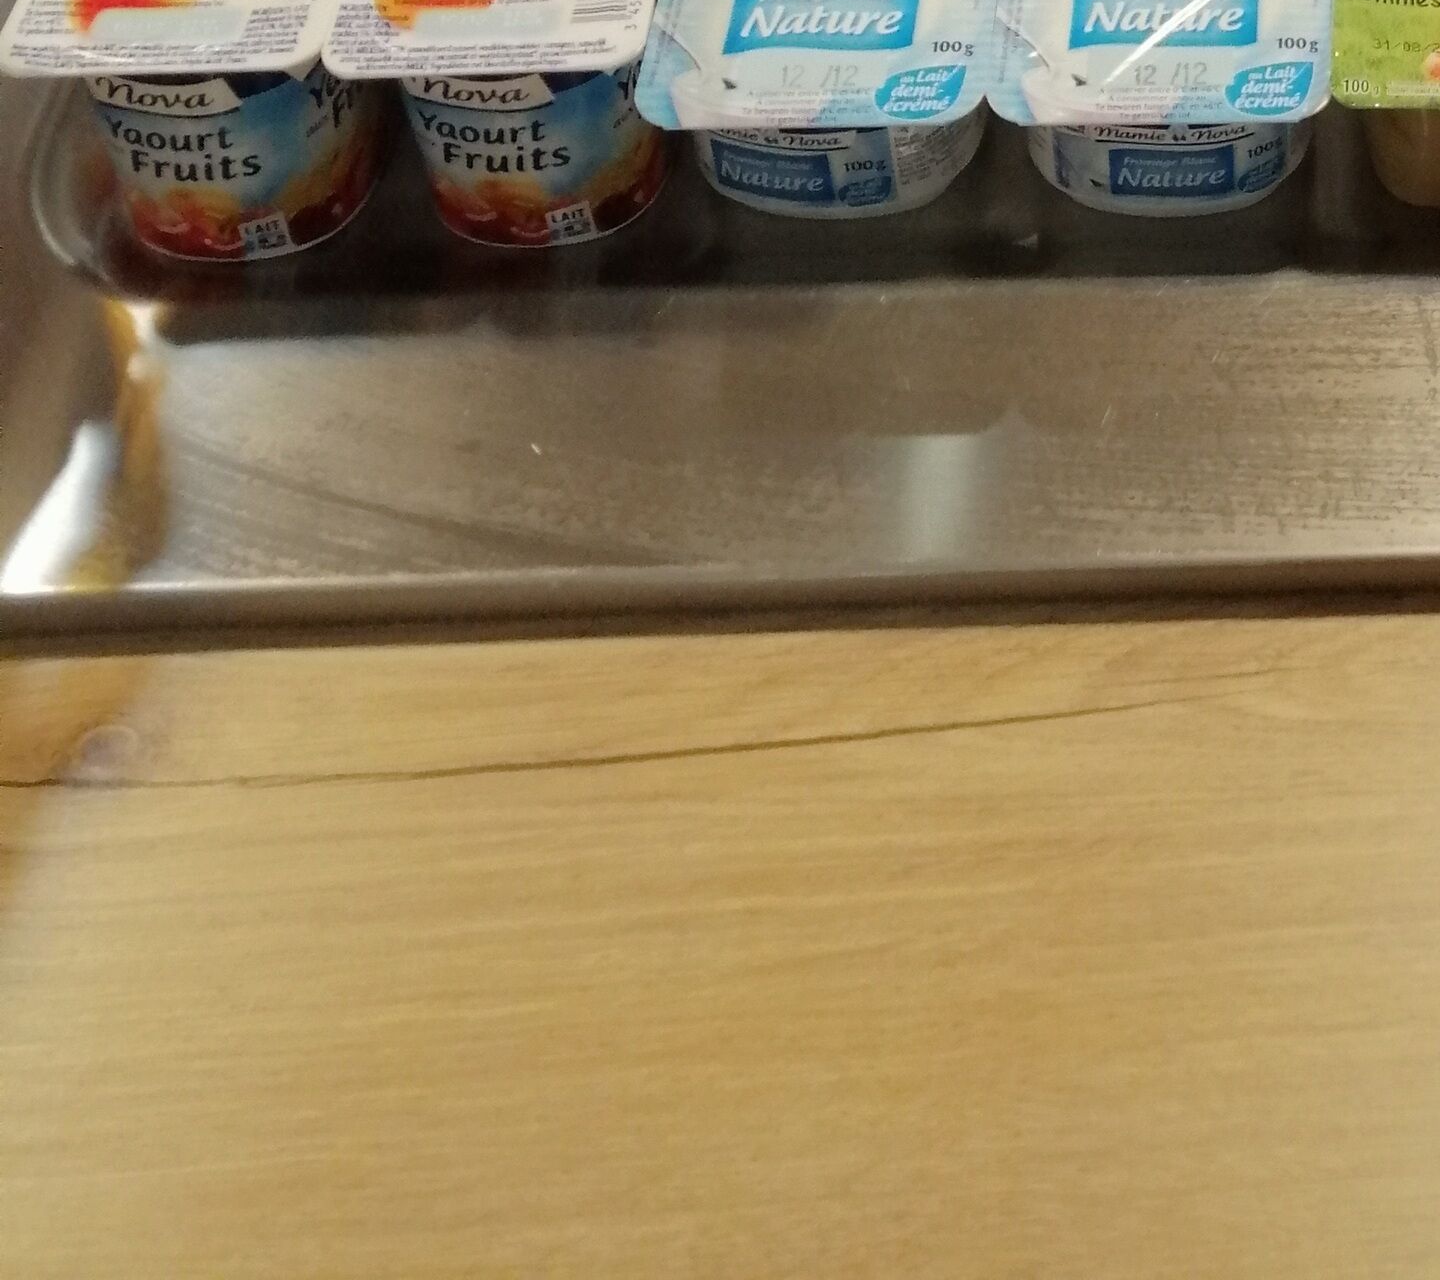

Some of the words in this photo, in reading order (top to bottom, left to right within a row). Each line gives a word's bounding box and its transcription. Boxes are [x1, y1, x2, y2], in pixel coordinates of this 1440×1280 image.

[741, 5, 902, 38] Nature
[1083, 4, 1243, 36] Nature
[97, 79, 213, 108] Nova
[424, 80, 523, 104] Nova
[106, 117, 233, 152] Yaourt
[418, 109, 547, 144] Yaourt
[131, 150, 262, 181] Fruits
[443, 142, 571, 173] Fruits
[244, 219, 280, 236] LAIT
[551, 208, 586, 225] LAIT
